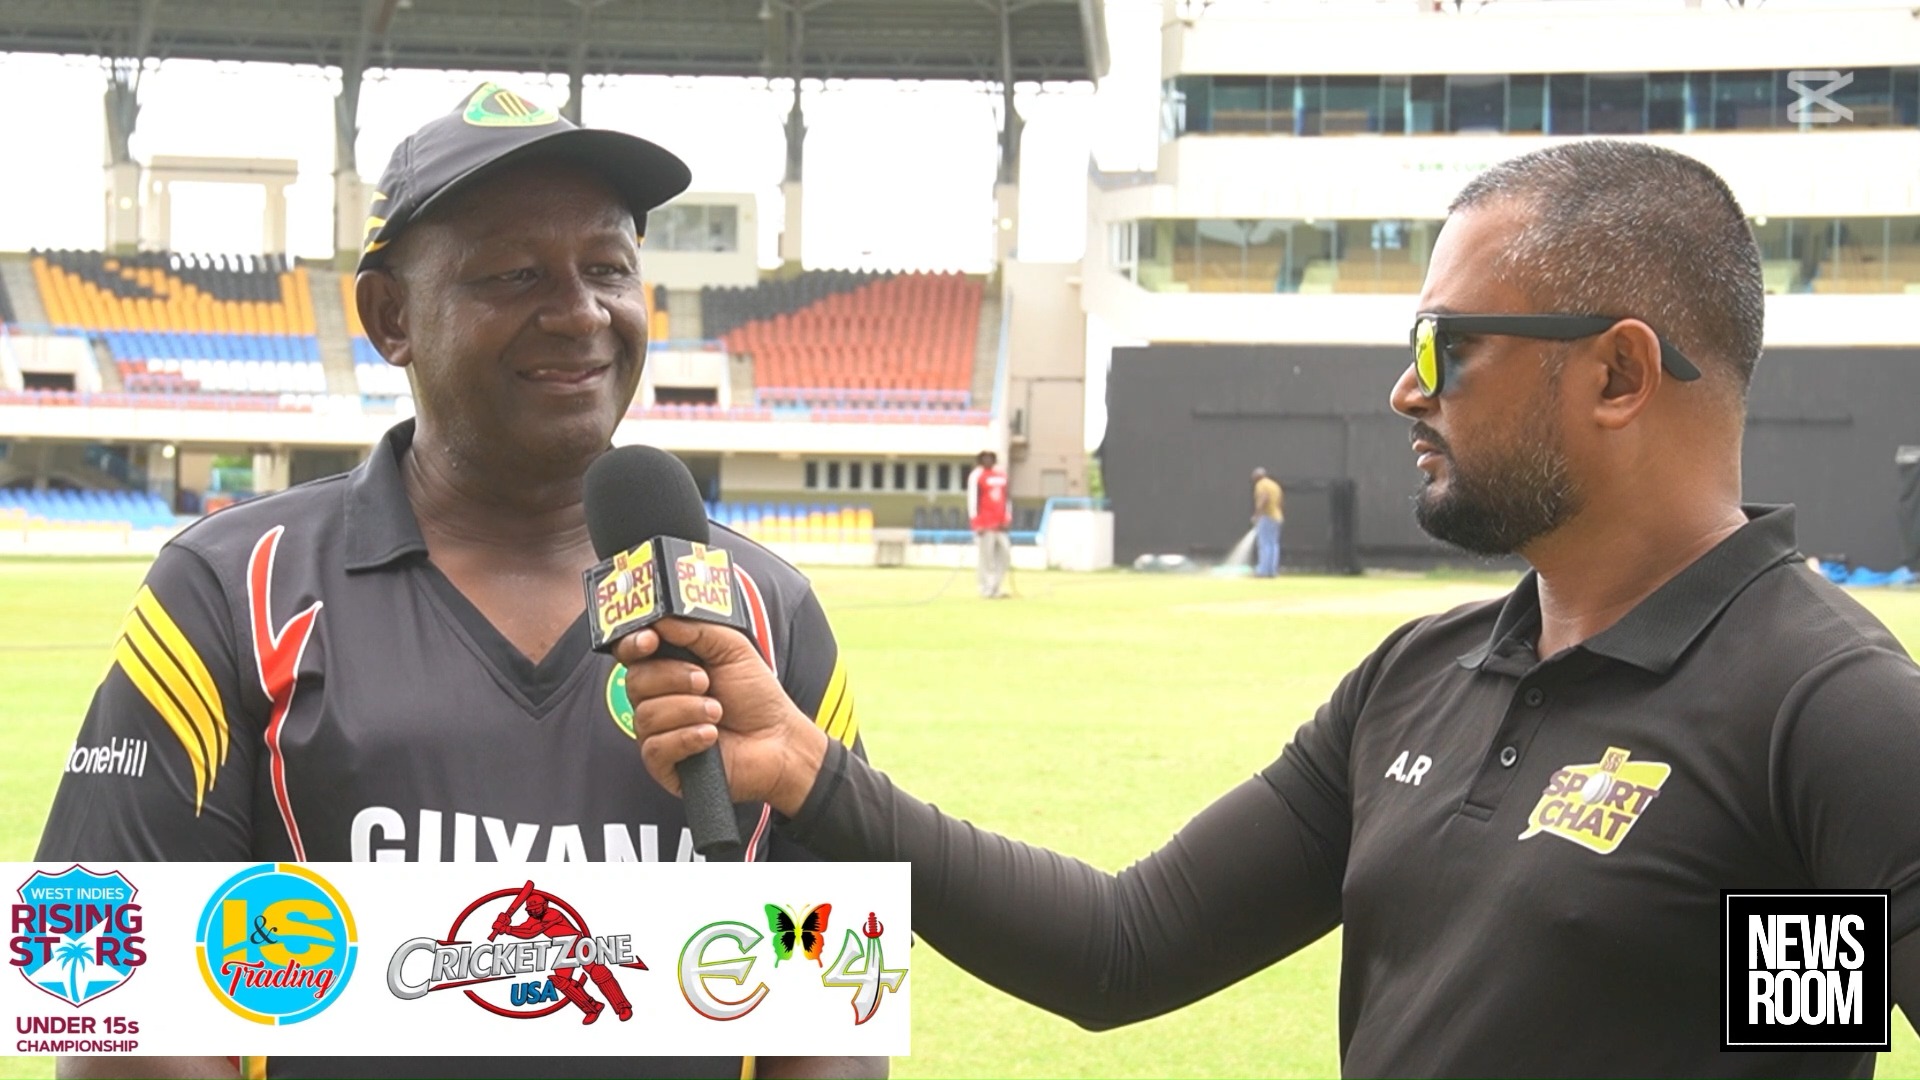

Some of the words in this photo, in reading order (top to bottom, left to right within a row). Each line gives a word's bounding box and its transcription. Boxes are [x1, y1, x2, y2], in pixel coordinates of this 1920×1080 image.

[604, 584, 652, 625] CHAT
[685, 583, 729, 607] CHAT
[1384, 751, 1433, 786] A.R
[1538, 800, 1633, 842] CHAT
